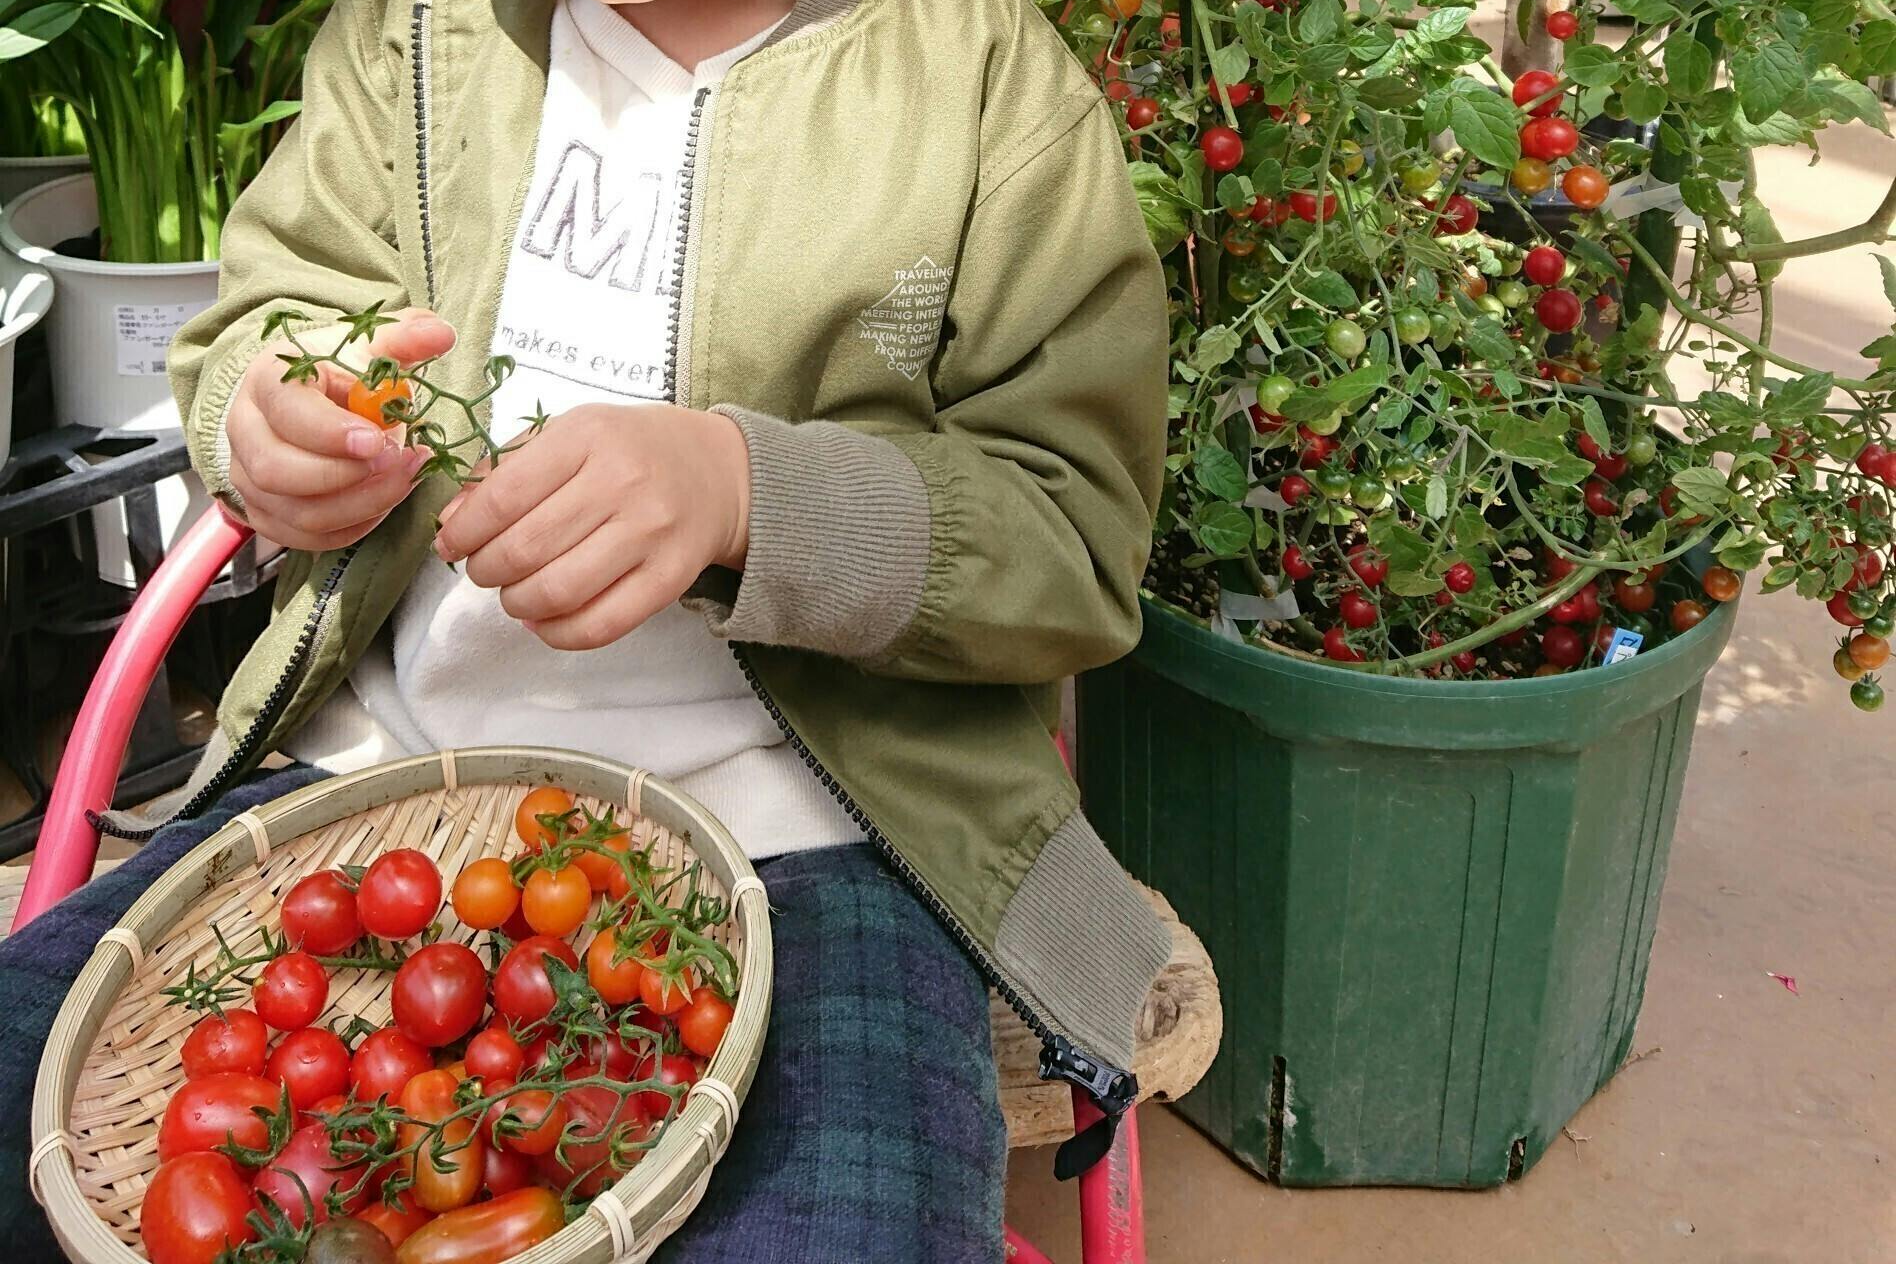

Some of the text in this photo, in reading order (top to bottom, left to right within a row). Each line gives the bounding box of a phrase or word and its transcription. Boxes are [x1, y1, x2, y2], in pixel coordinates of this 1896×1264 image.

[894, 266, 954, 281] TRAVELING
[899, 282, 947, 296] AROUND
[891, 298, 912, 308] THE
[860, 309, 913, 321] MEETING
[501, 325, 578, 363] makes
[860, 330, 907, 345] MAKING
[910, 332, 933, 345] NEW
[875, 344, 907, 359] FROM
